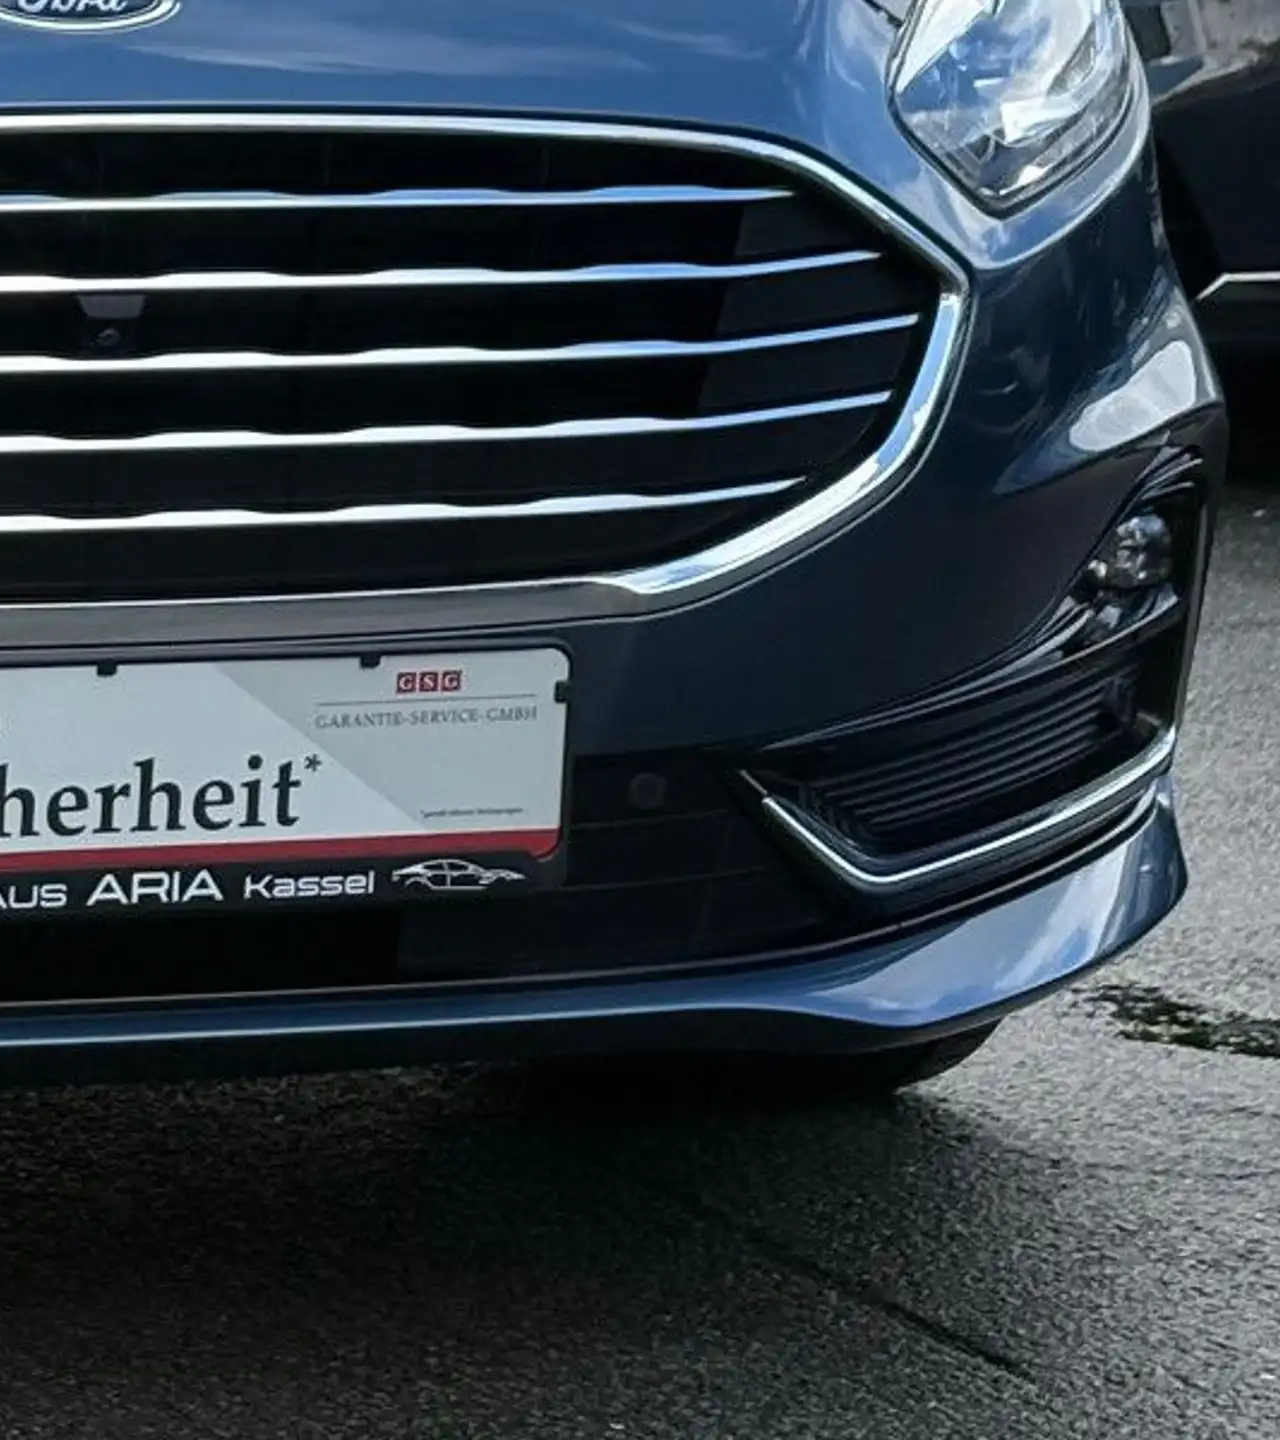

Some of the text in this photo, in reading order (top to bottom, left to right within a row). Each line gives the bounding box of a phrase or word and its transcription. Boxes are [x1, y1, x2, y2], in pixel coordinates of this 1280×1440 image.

[396, 670, 463, 694] GSG
[86, 868, 225, 906] ARIA
[243, 870, 376, 899] Kassel
